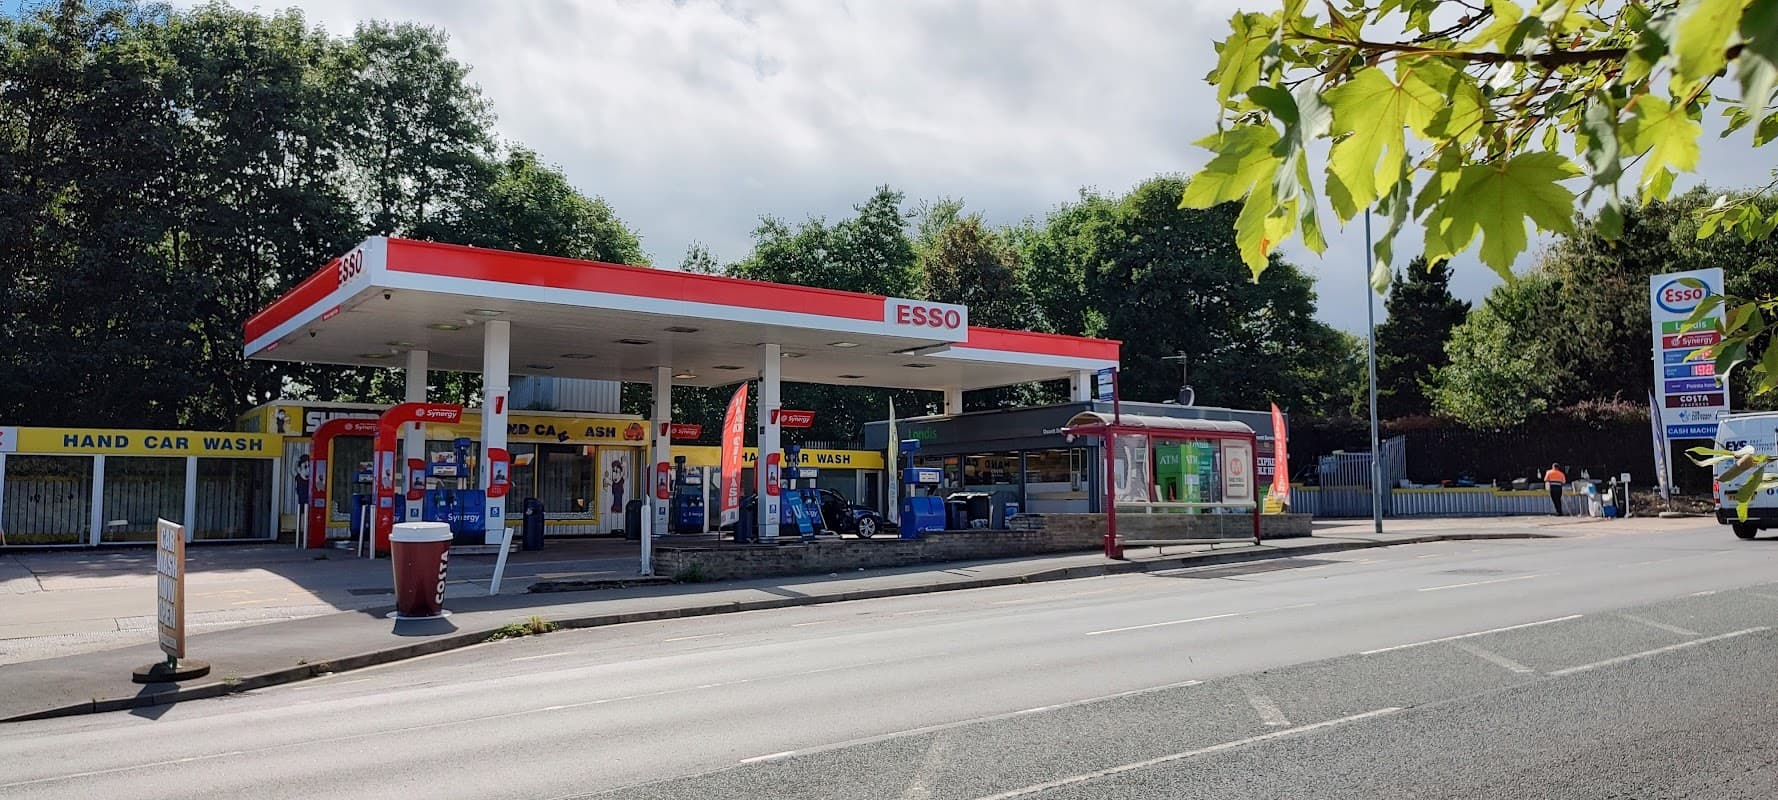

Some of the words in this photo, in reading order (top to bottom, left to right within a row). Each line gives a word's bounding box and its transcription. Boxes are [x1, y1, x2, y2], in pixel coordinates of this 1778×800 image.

[338, 249, 363, 285] ESSO
[1665, 289, 1703, 303] Esso
[897, 304, 961, 329] ESSO
[1675, 320, 1707, 330] Ldis
[1682, 336, 1713, 346] Synergy
[1680, 394, 1709, 402] COSTA
[427, 409, 457, 419] Synergy
[507, 423, 530, 435] ND
[1668, 427, 1689, 435] CASH
[63, 434, 130, 448] HAND
[144, 436, 189, 449] CAR
[203, 438, 263, 451] WASH
[817, 454, 851, 464] WASH
[1160, 455, 1179, 465] ATM
[161, 527, 175, 554] CAR
[157, 550, 177, 580] WASH
[435, 550, 449, 605] COSTA
